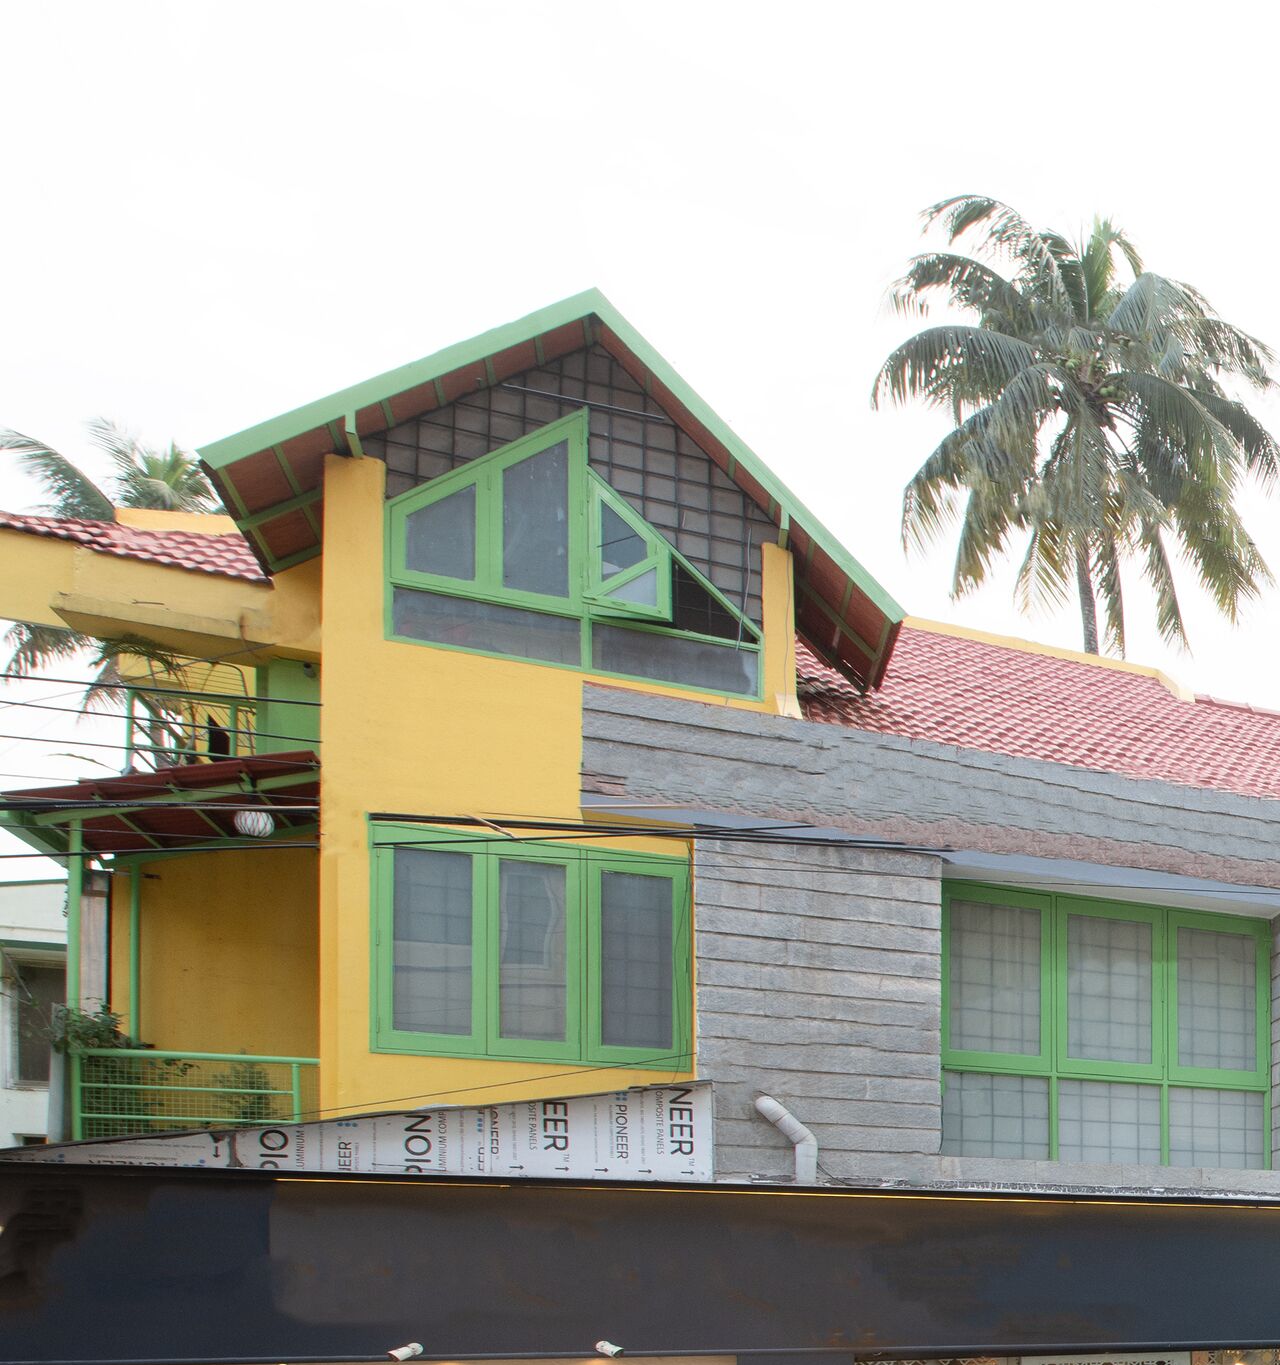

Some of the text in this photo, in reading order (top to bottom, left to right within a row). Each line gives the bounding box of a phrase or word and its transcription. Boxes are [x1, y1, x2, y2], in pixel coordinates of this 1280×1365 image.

[528, 1123, 538, 1151] PANELS
[615, 1104, 629, 1159] PIONEER
[656, 1128, 665, 1155] PANELS
